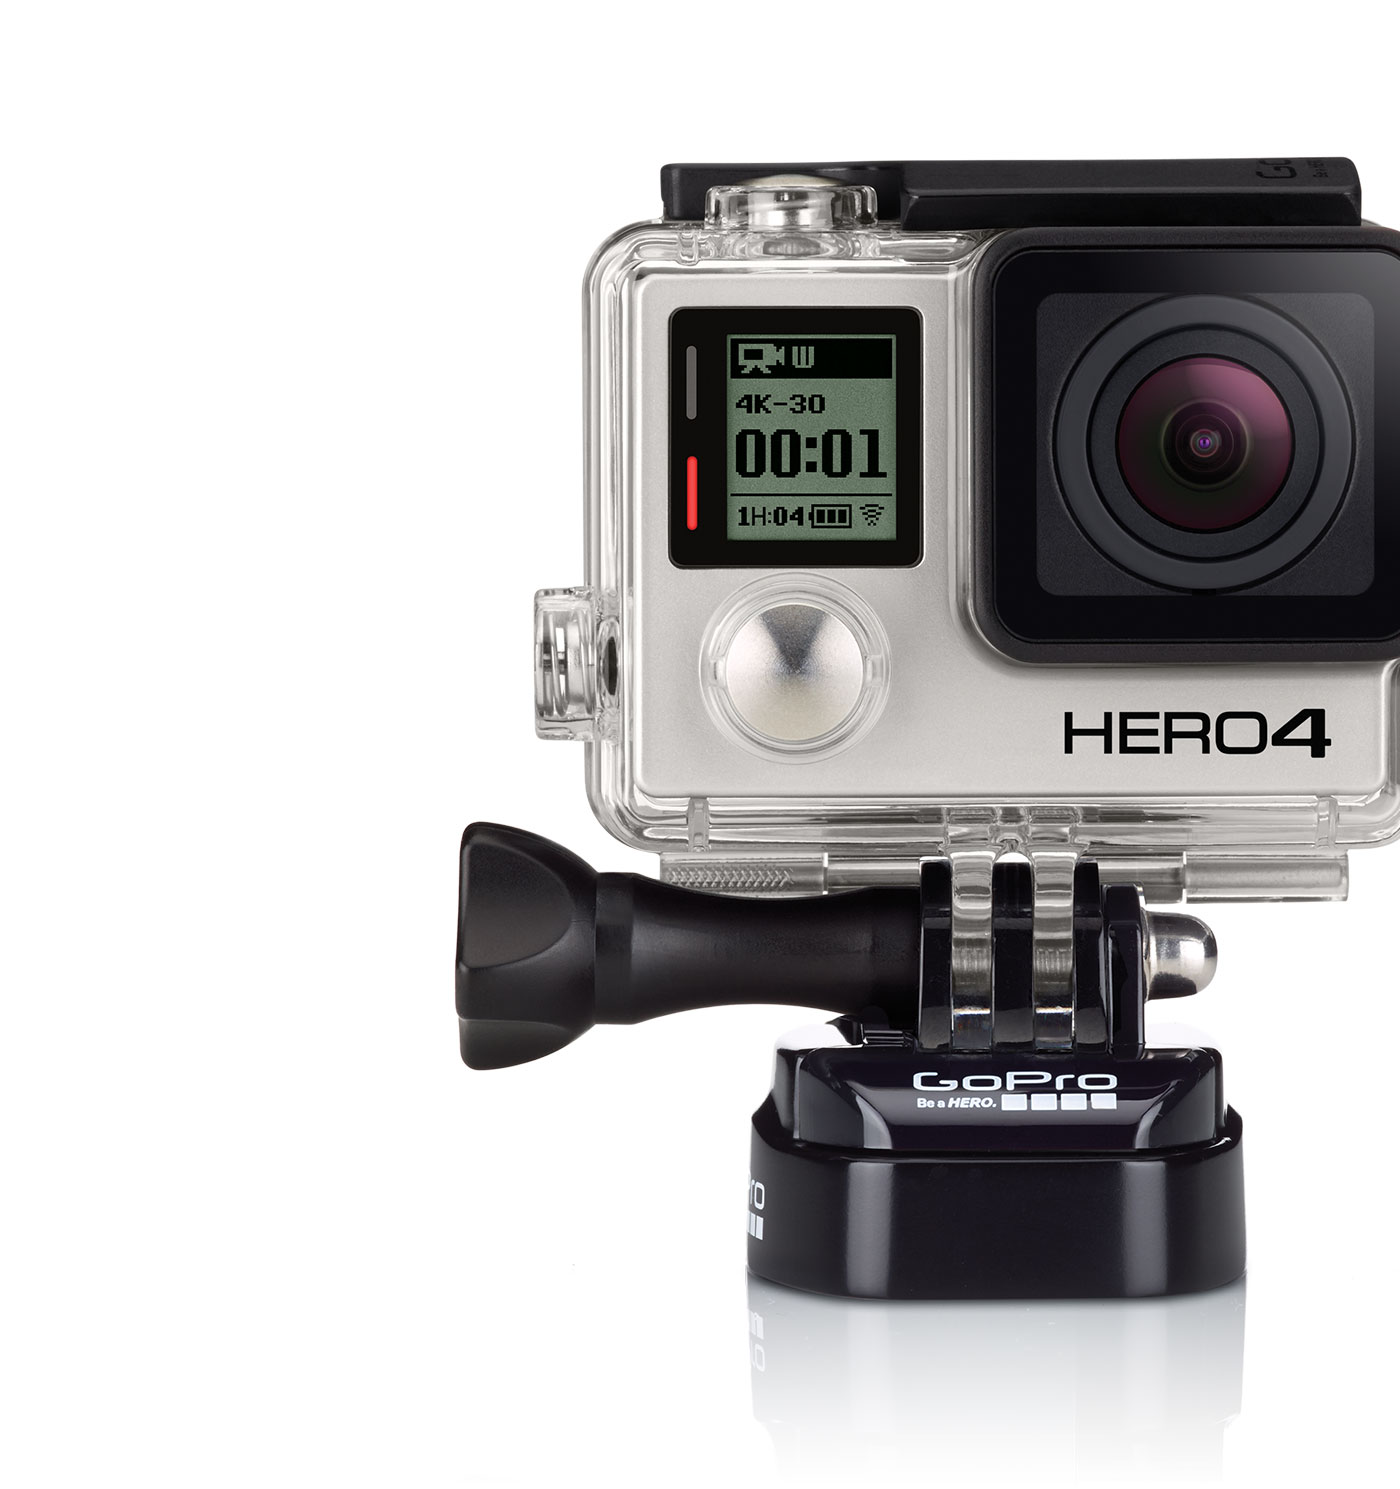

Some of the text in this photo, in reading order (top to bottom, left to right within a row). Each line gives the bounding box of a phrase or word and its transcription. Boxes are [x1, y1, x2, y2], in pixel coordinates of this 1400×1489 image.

[792, 346, 815, 369] W
[736, 394, 826, 414] 4K-30
[735, 429, 888, 478] 00:01
[738, 506, 804, 527] 1H:04
[1063, 708, 1332, 758] HERO4
[913, 1071, 1118, 1092] GoPro
[917, 1097, 998, 1109] Be a HERO.
